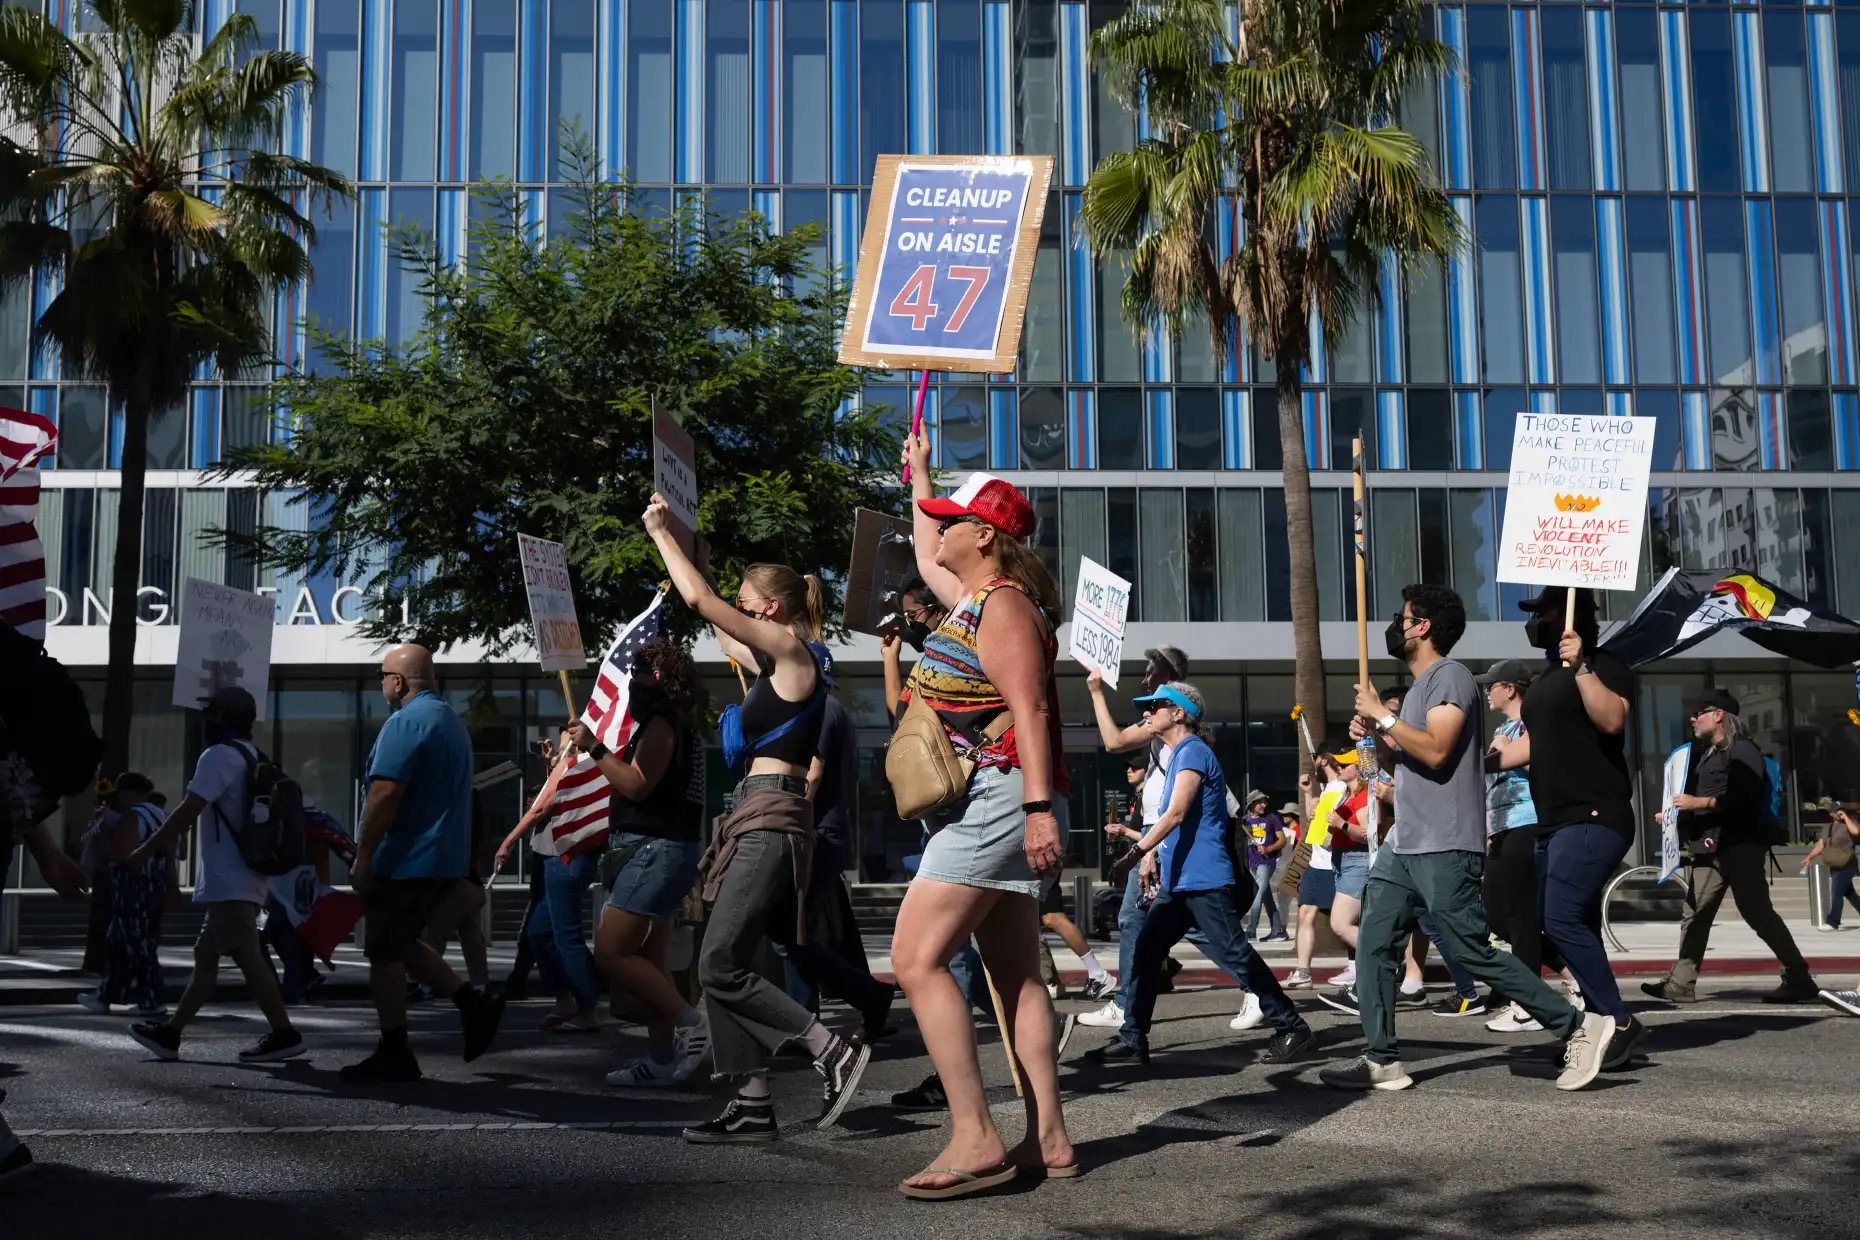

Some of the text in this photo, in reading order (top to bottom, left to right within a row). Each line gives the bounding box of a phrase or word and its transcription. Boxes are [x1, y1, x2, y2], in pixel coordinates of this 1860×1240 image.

[906, 188, 1013, 209] CLEANUP
[897, 232, 1002, 254] ON AISLE
[889, 264, 991, 333] 47
[1523, 415, 1633, 435] THOSE WHO
[1517, 435, 1650, 454] MAKE PEACEFUL
[1547, 455, 1624, 474] PROTEST
[1511, 470, 1635, 491] IMPOSSIBLE
[1537, 515, 1630, 534] WILL MAKE
[1532, 529, 1609, 544] VIOLENT
[1515, 542, 1610, 557] REVOLUTION
[192, 582, 236, 606] NEVER
[1081, 577, 1126, 625] MORE 1776
[46, 586, 168, 626] ONG
[199, 606, 243, 629] MEANS
[221, 629, 256, 652] NOW
[1075, 621, 1120, 676] LESS 1984
[1283, 841, 1312, 889] NOTHI
